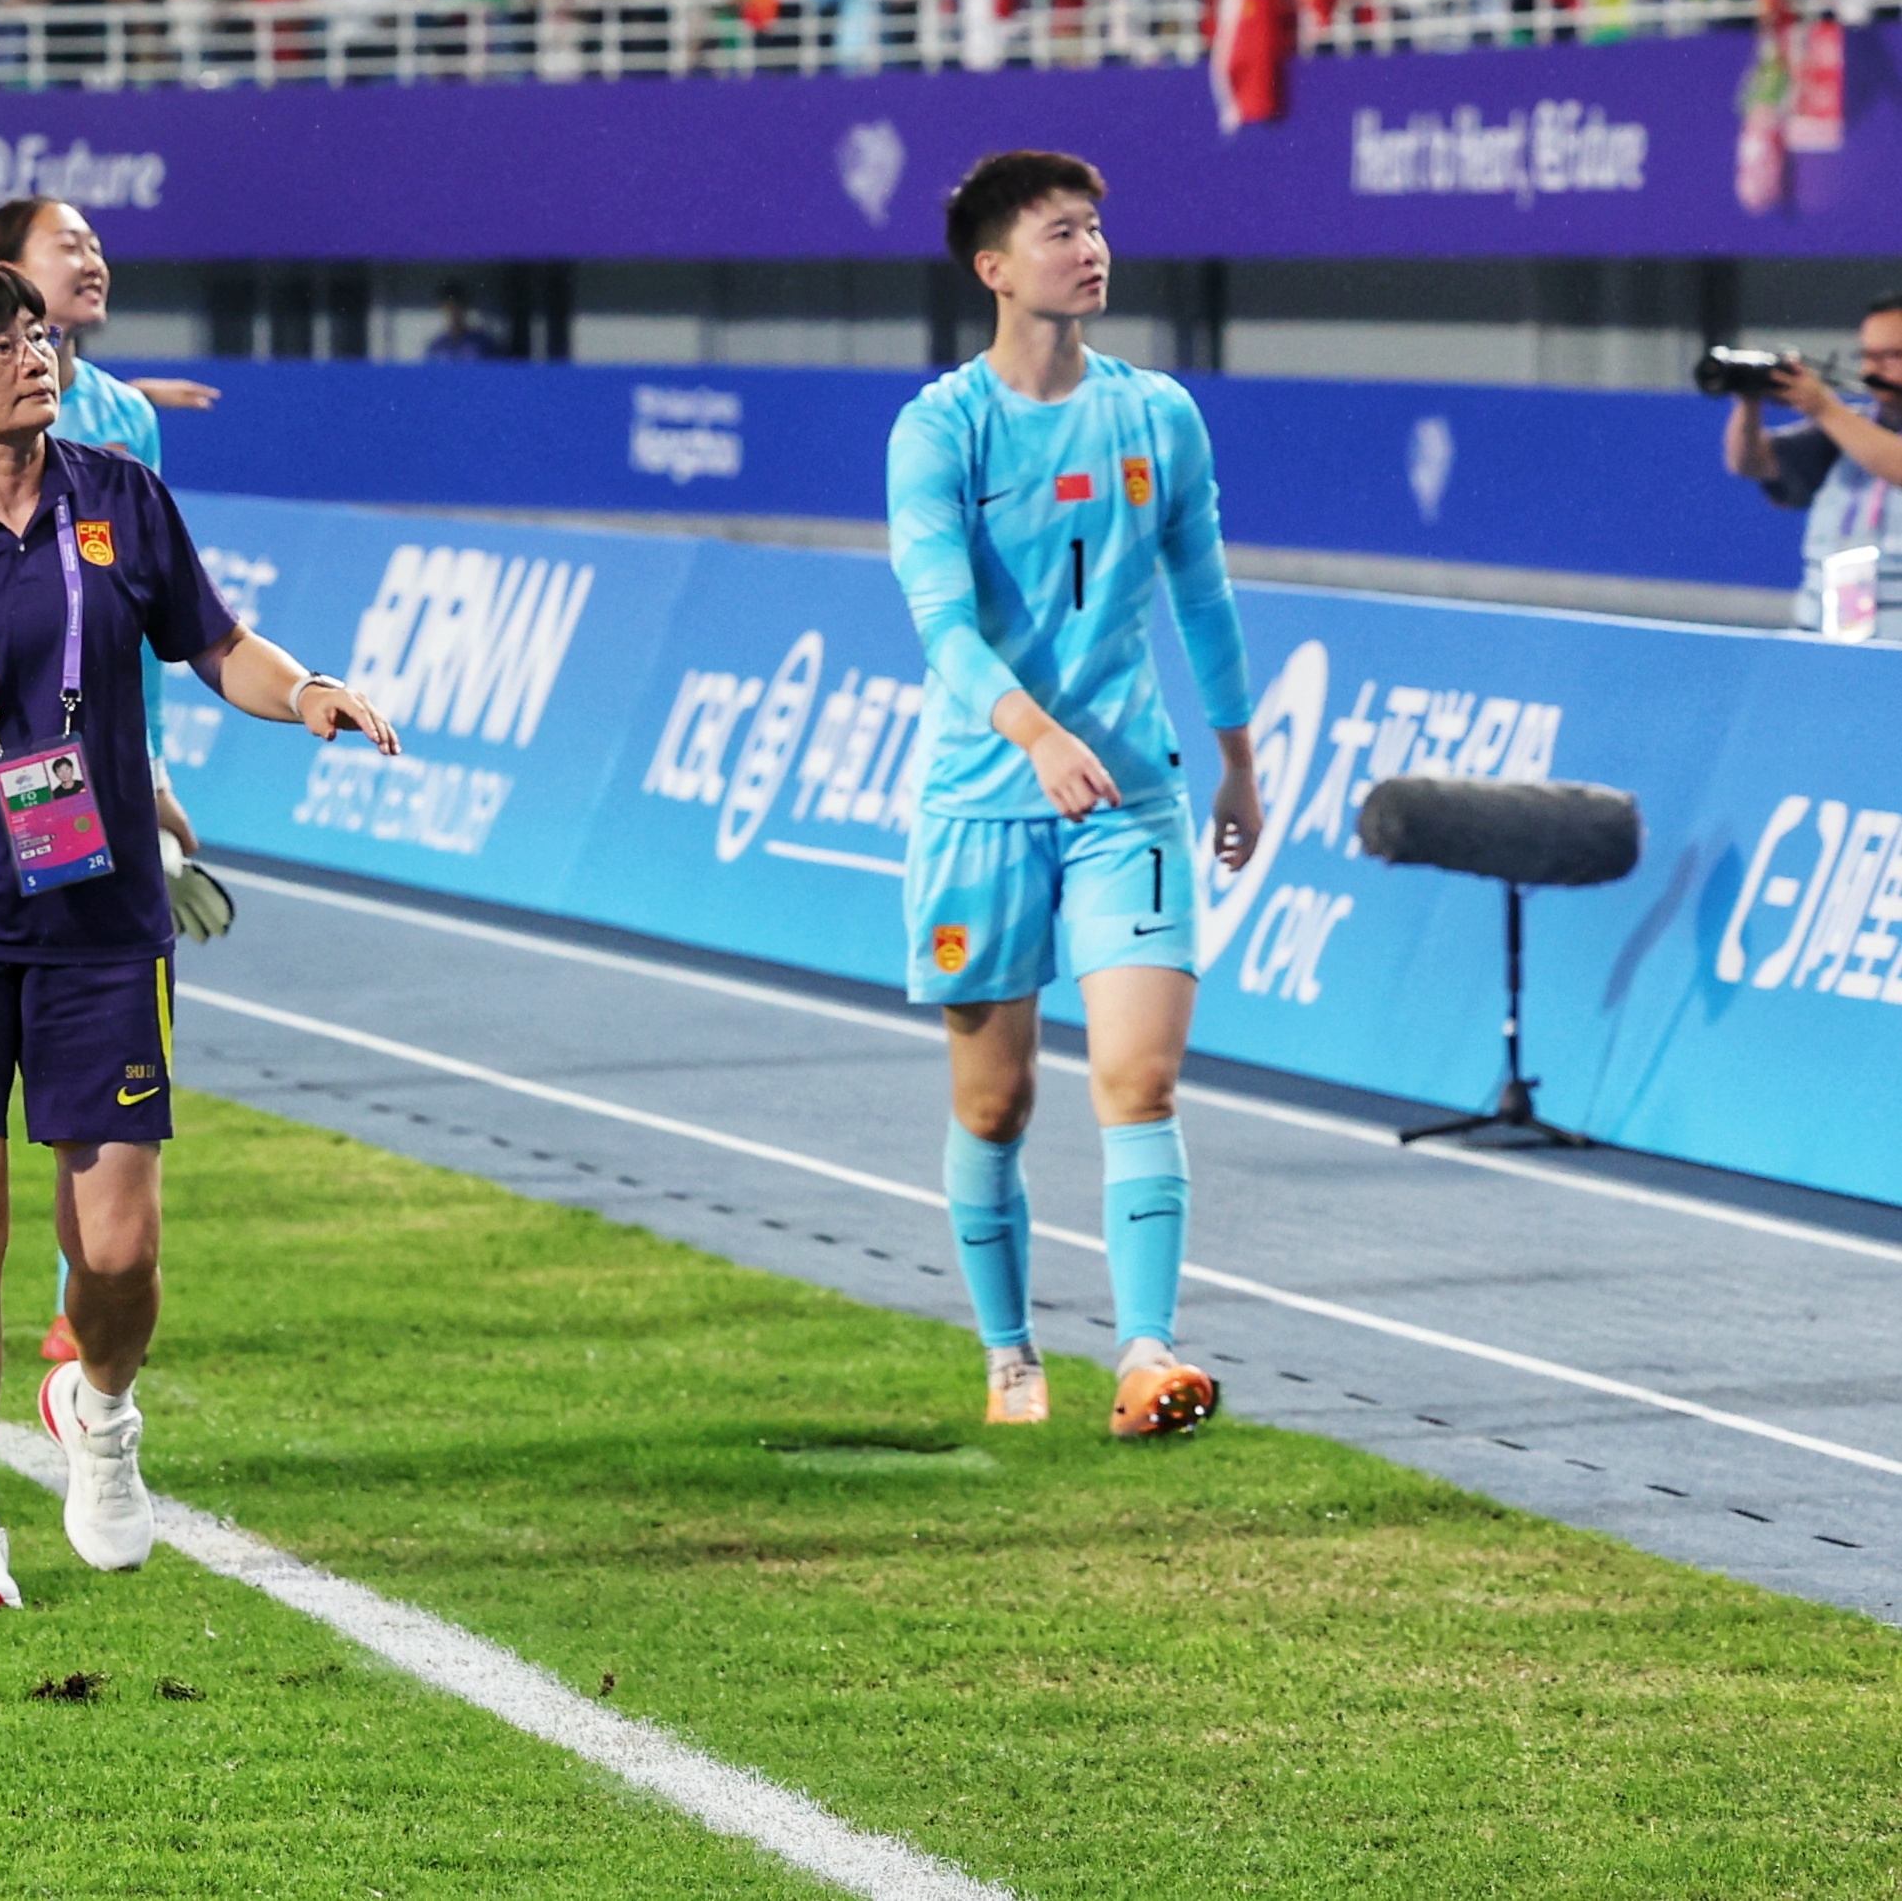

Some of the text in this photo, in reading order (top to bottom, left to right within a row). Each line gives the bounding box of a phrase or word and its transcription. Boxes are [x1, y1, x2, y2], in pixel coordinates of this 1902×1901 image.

[1070, 538, 1084, 611] 1
[87, 854, 106, 870] 2R
[1149, 846, 1163, 913] 1
